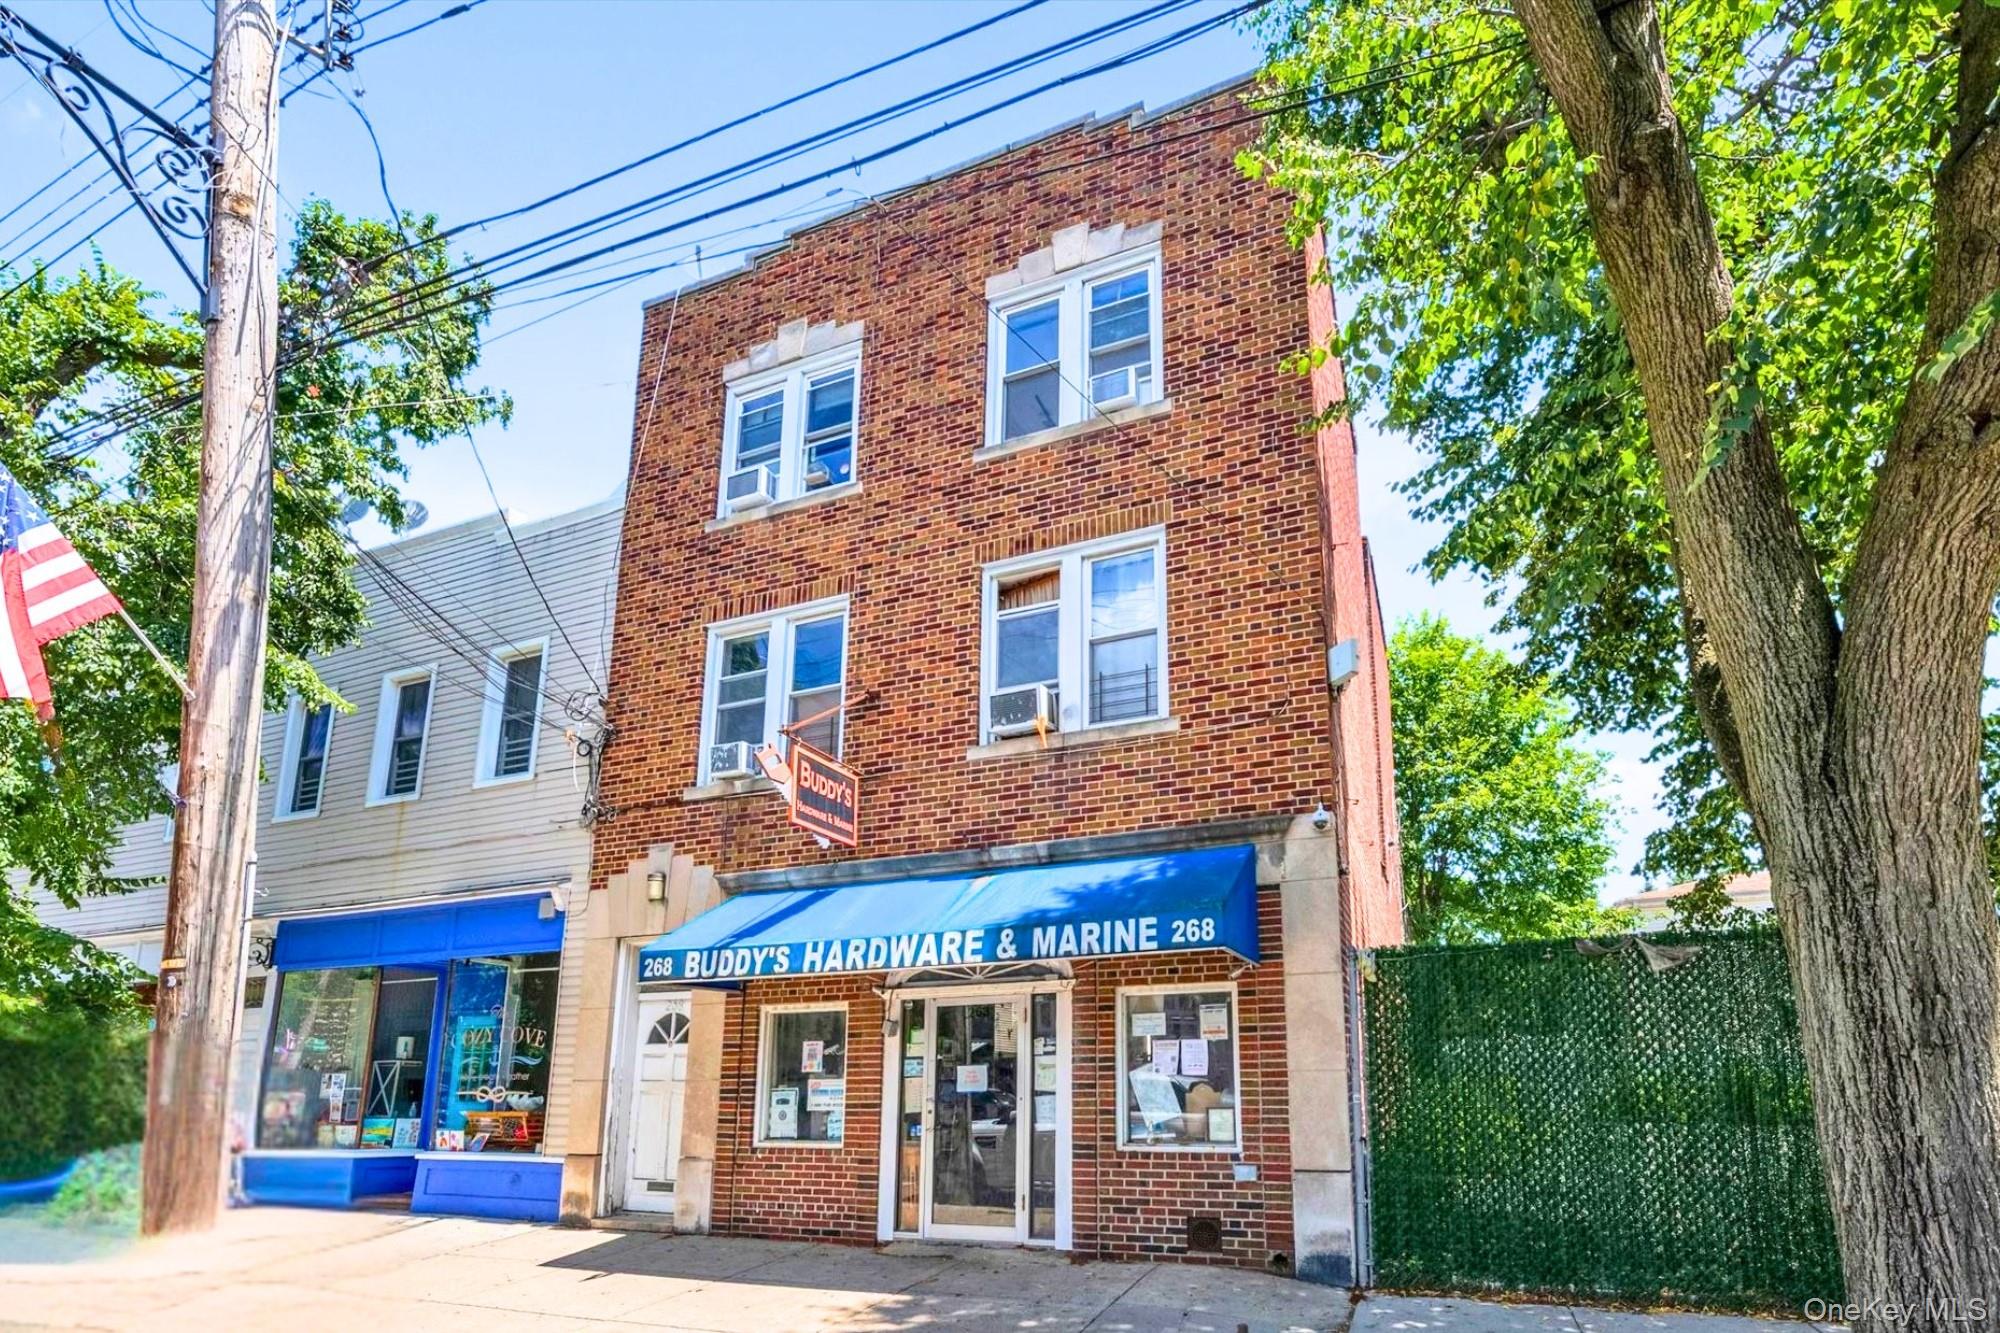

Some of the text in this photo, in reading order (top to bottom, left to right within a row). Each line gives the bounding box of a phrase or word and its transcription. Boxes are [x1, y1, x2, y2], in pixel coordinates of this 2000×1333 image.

[644, 916, 1215, 978] 268 BUDDY'S HARDWARE & MARINE 268
[508, 1026, 547, 1049] OVE
